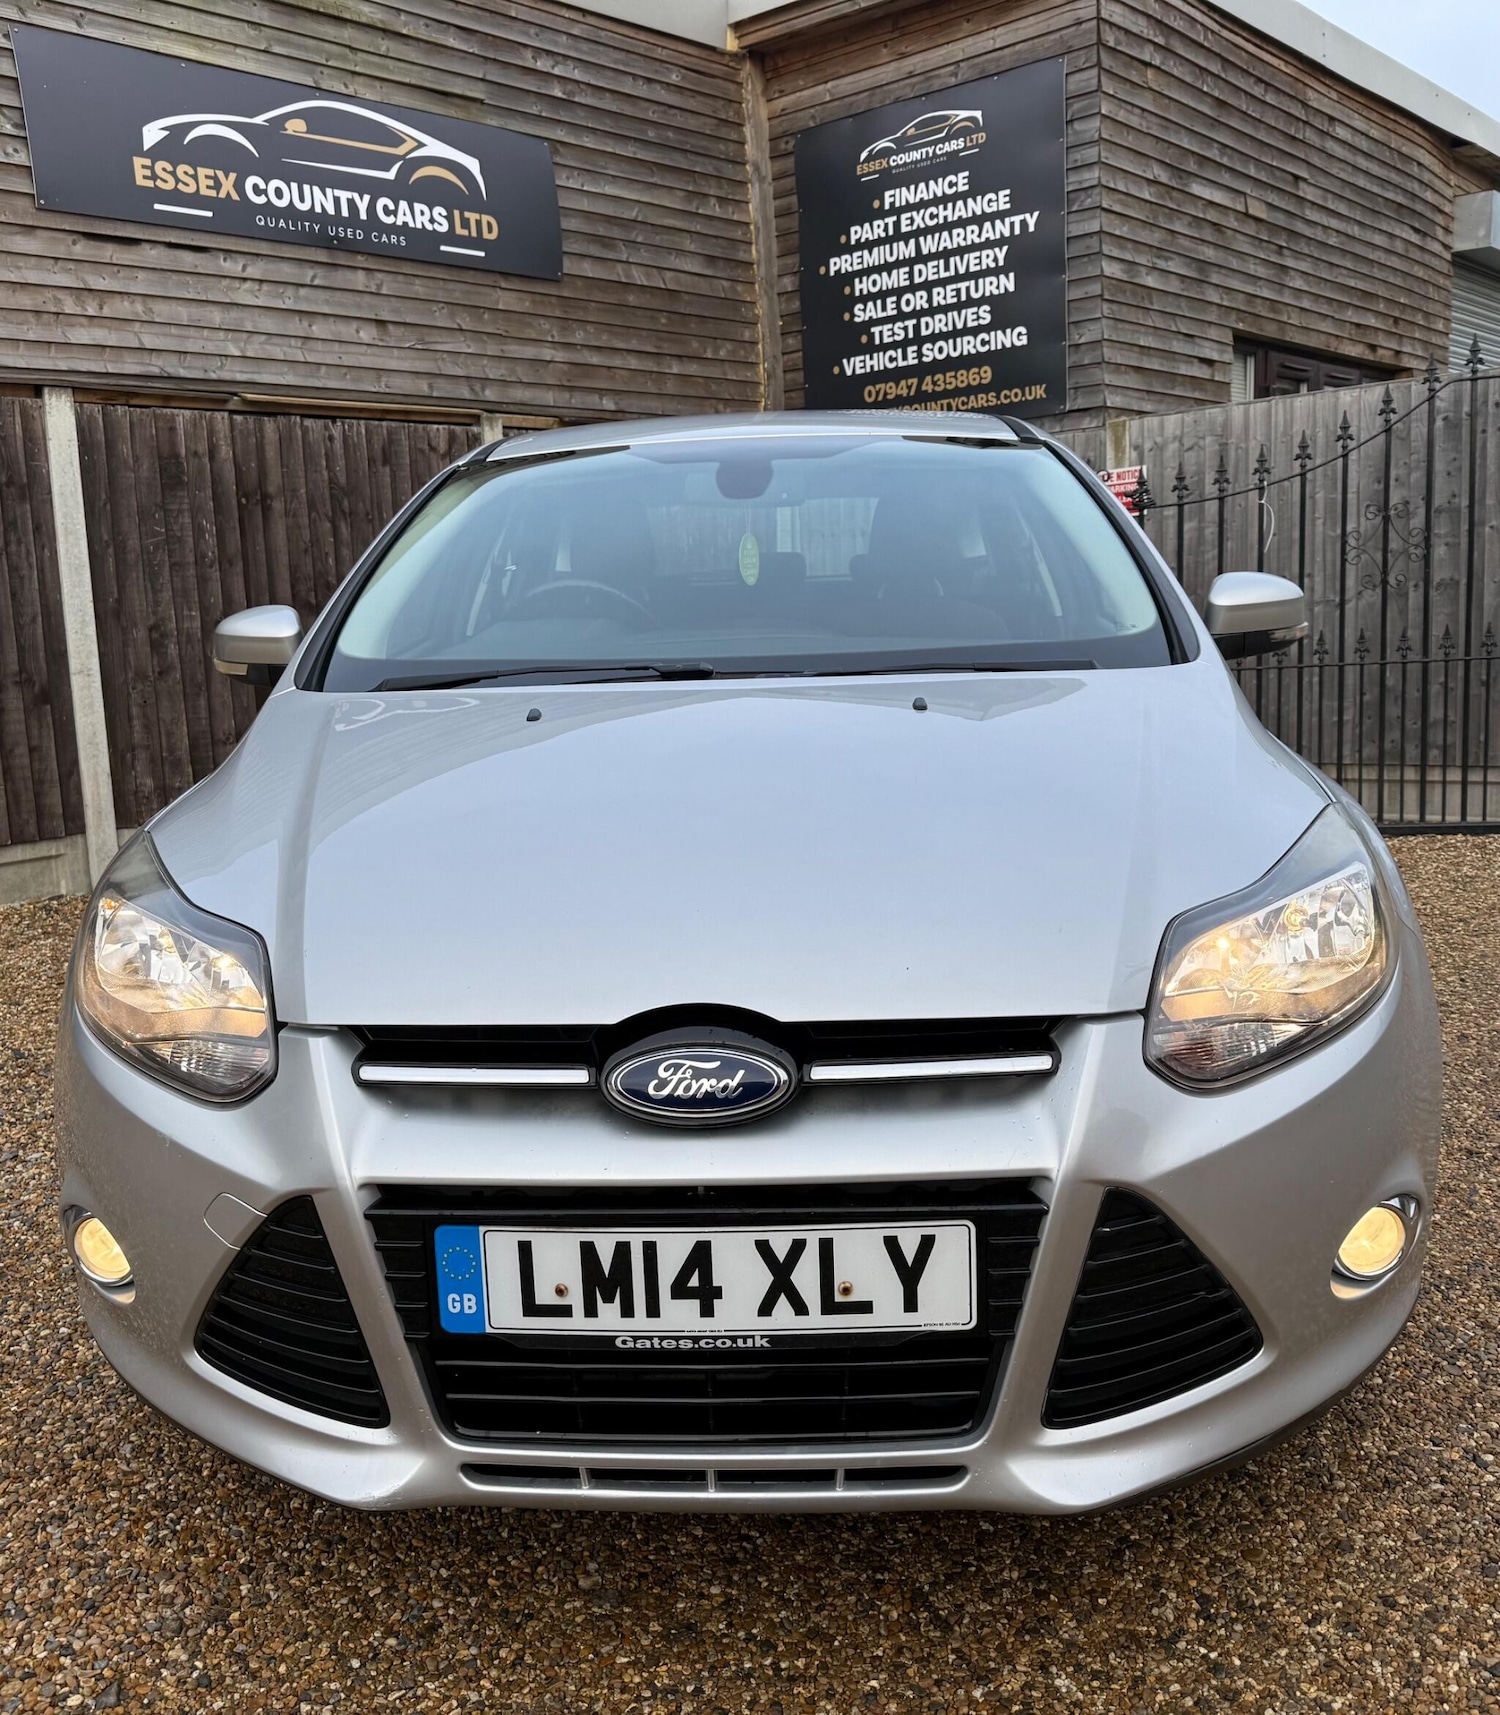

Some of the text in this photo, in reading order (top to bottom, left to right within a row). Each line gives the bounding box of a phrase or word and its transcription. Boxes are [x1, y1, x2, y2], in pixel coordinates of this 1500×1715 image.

[856, 132, 986, 175] ESSEX COUNTY CARS LTD
[132, 156, 499, 241] ESSEX COUNTY CARS LTD
[884, 171, 970, 210] FINANCE
[255, 214, 407, 247] QUALITY USED CARS
[850, 189, 1011, 245] PART EXCHANGE
[829, 211, 1040, 277] PREMIUM WARRANTY
[854, 246, 1009, 297] HOME DELIVERY
[853, 272, 1016, 323] SALE OR RETURN
[870, 305, 992, 345] TEST DRIVES
[842, 326, 1028, 377] VEHICLE SOURCING
[863, 365, 993, 403] 07947 435869
[1116, 469, 1141, 481] NOTIC
[647, 1059, 745, 1099] Ford
[517, 1234, 937, 1318] LM14 XLY
[447, 1293, 477, 1315] GB
[614, 1335, 771, 1349] Gates.co.uk
